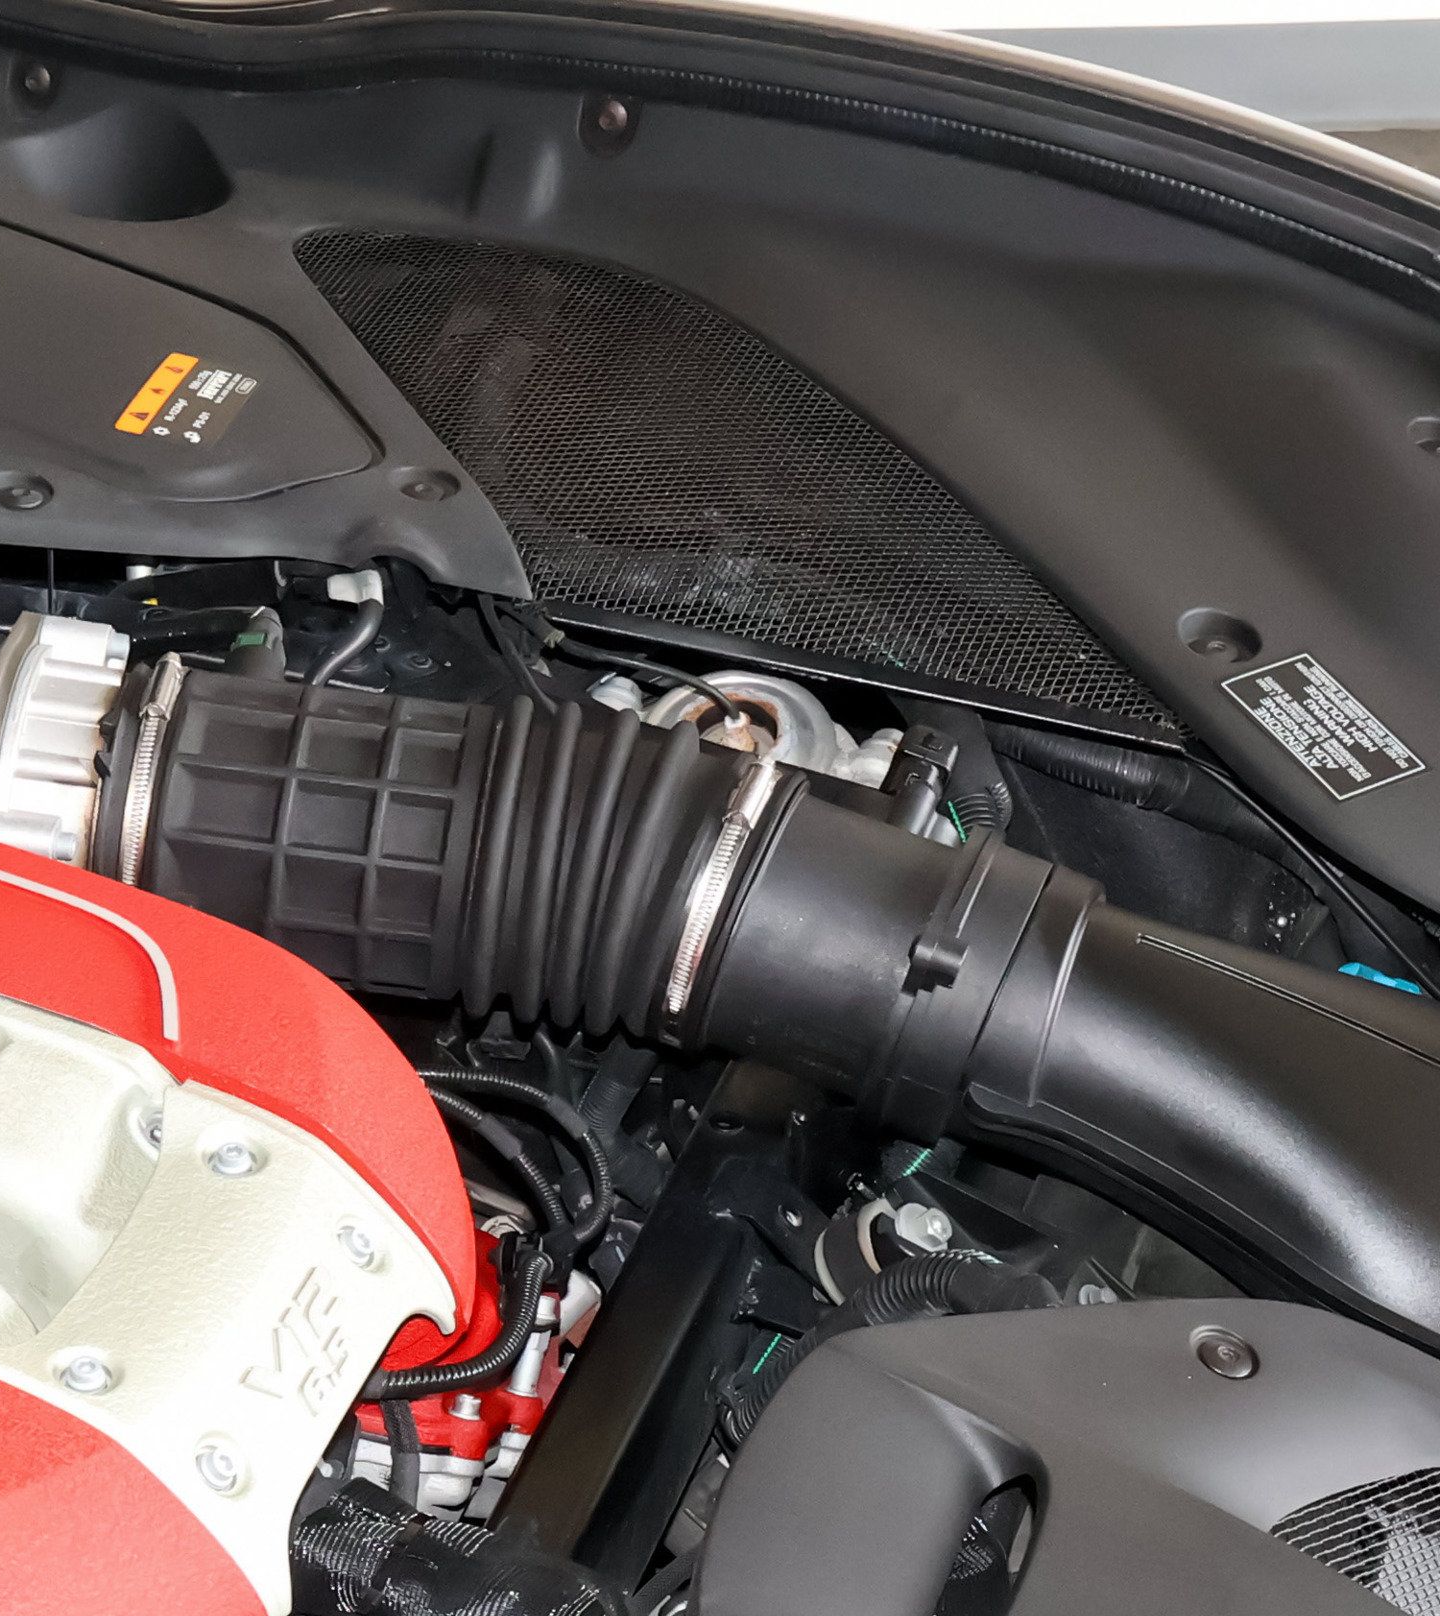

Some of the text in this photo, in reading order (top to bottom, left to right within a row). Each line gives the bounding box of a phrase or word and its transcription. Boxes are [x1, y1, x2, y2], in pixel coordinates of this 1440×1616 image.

[1254, 706, 1321, 766] ATTENZIONE
[1259, 696, 1338, 768] ALTA TENSIONE
[1303, 684, 1377, 752] HIGH VOLTAGE
[1303, 698, 1354, 746] WARNING
